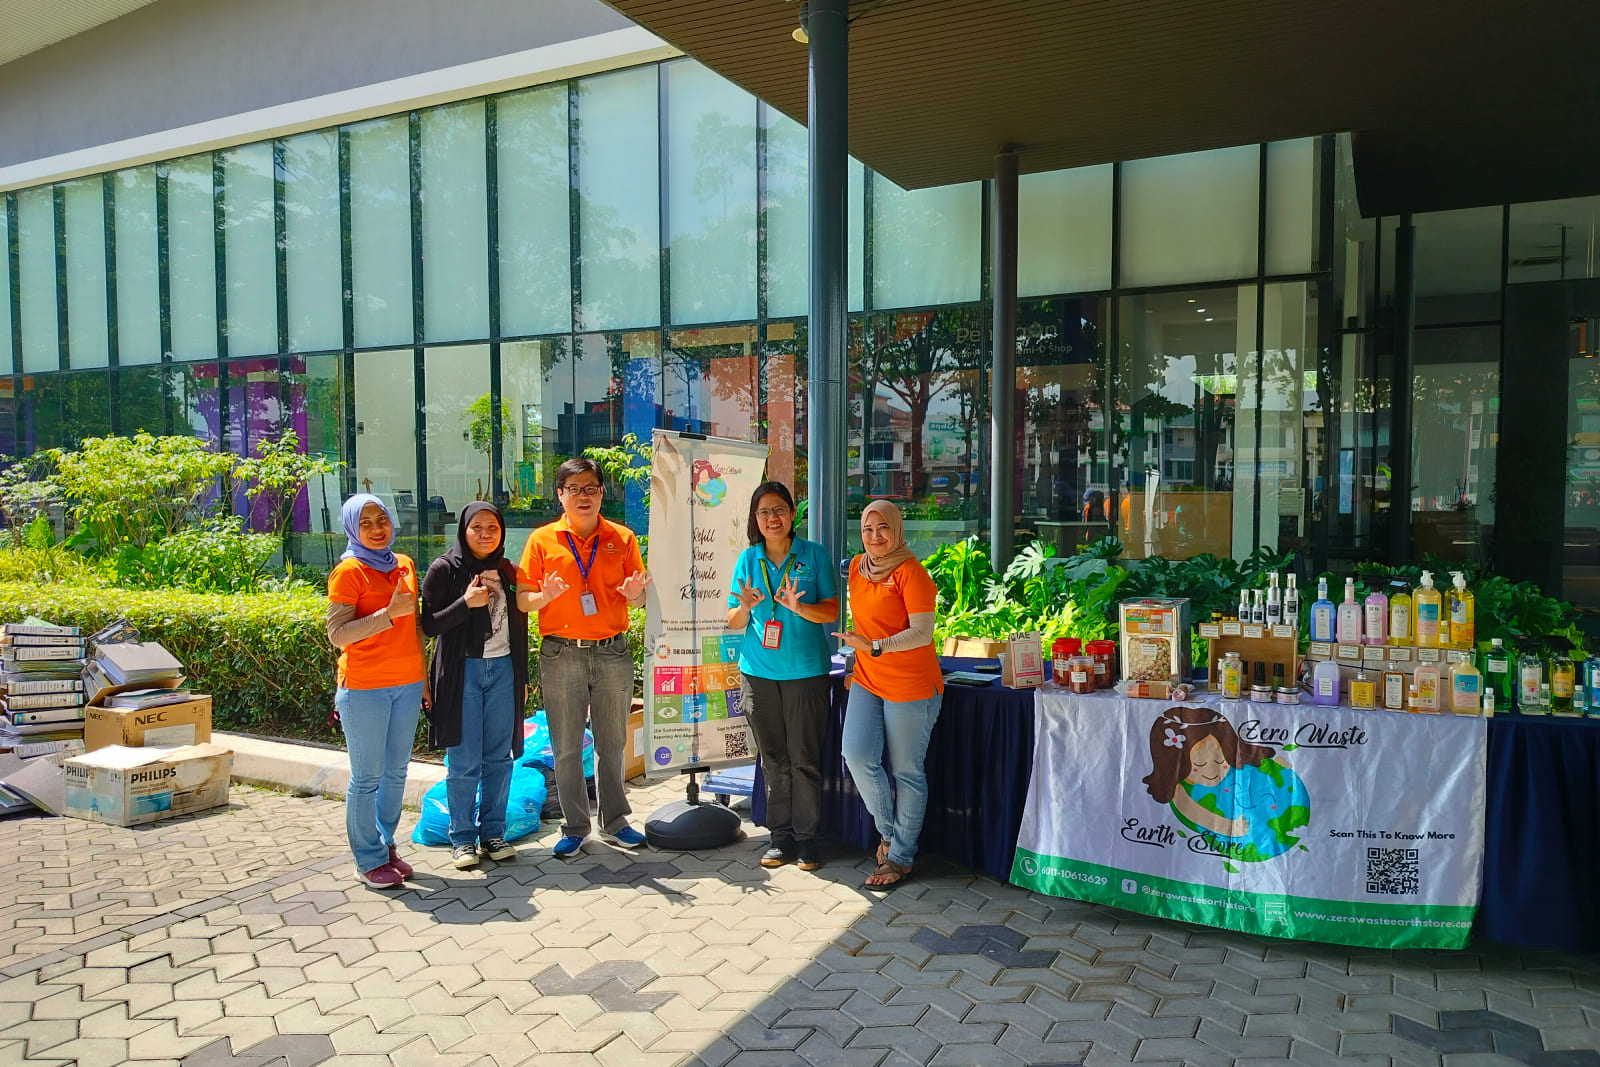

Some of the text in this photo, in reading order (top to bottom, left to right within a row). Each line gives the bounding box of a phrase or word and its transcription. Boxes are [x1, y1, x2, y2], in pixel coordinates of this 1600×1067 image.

[89, 712, 103, 720] NEC
[135, 711, 168, 726] NEC
[1237, 719, 1368, 749] Zero Waste
[66, 765, 89, 779] PHILIP
[130, 767, 177, 784] PHILIPS
[1121, 818, 1246, 859] Earth Store
[1329, 829, 1455, 840] Scan This To Know More
[1041, 866, 1108, 886] 6011-10613629
[1142, 884, 1257, 913] @zerowasteearthstore
